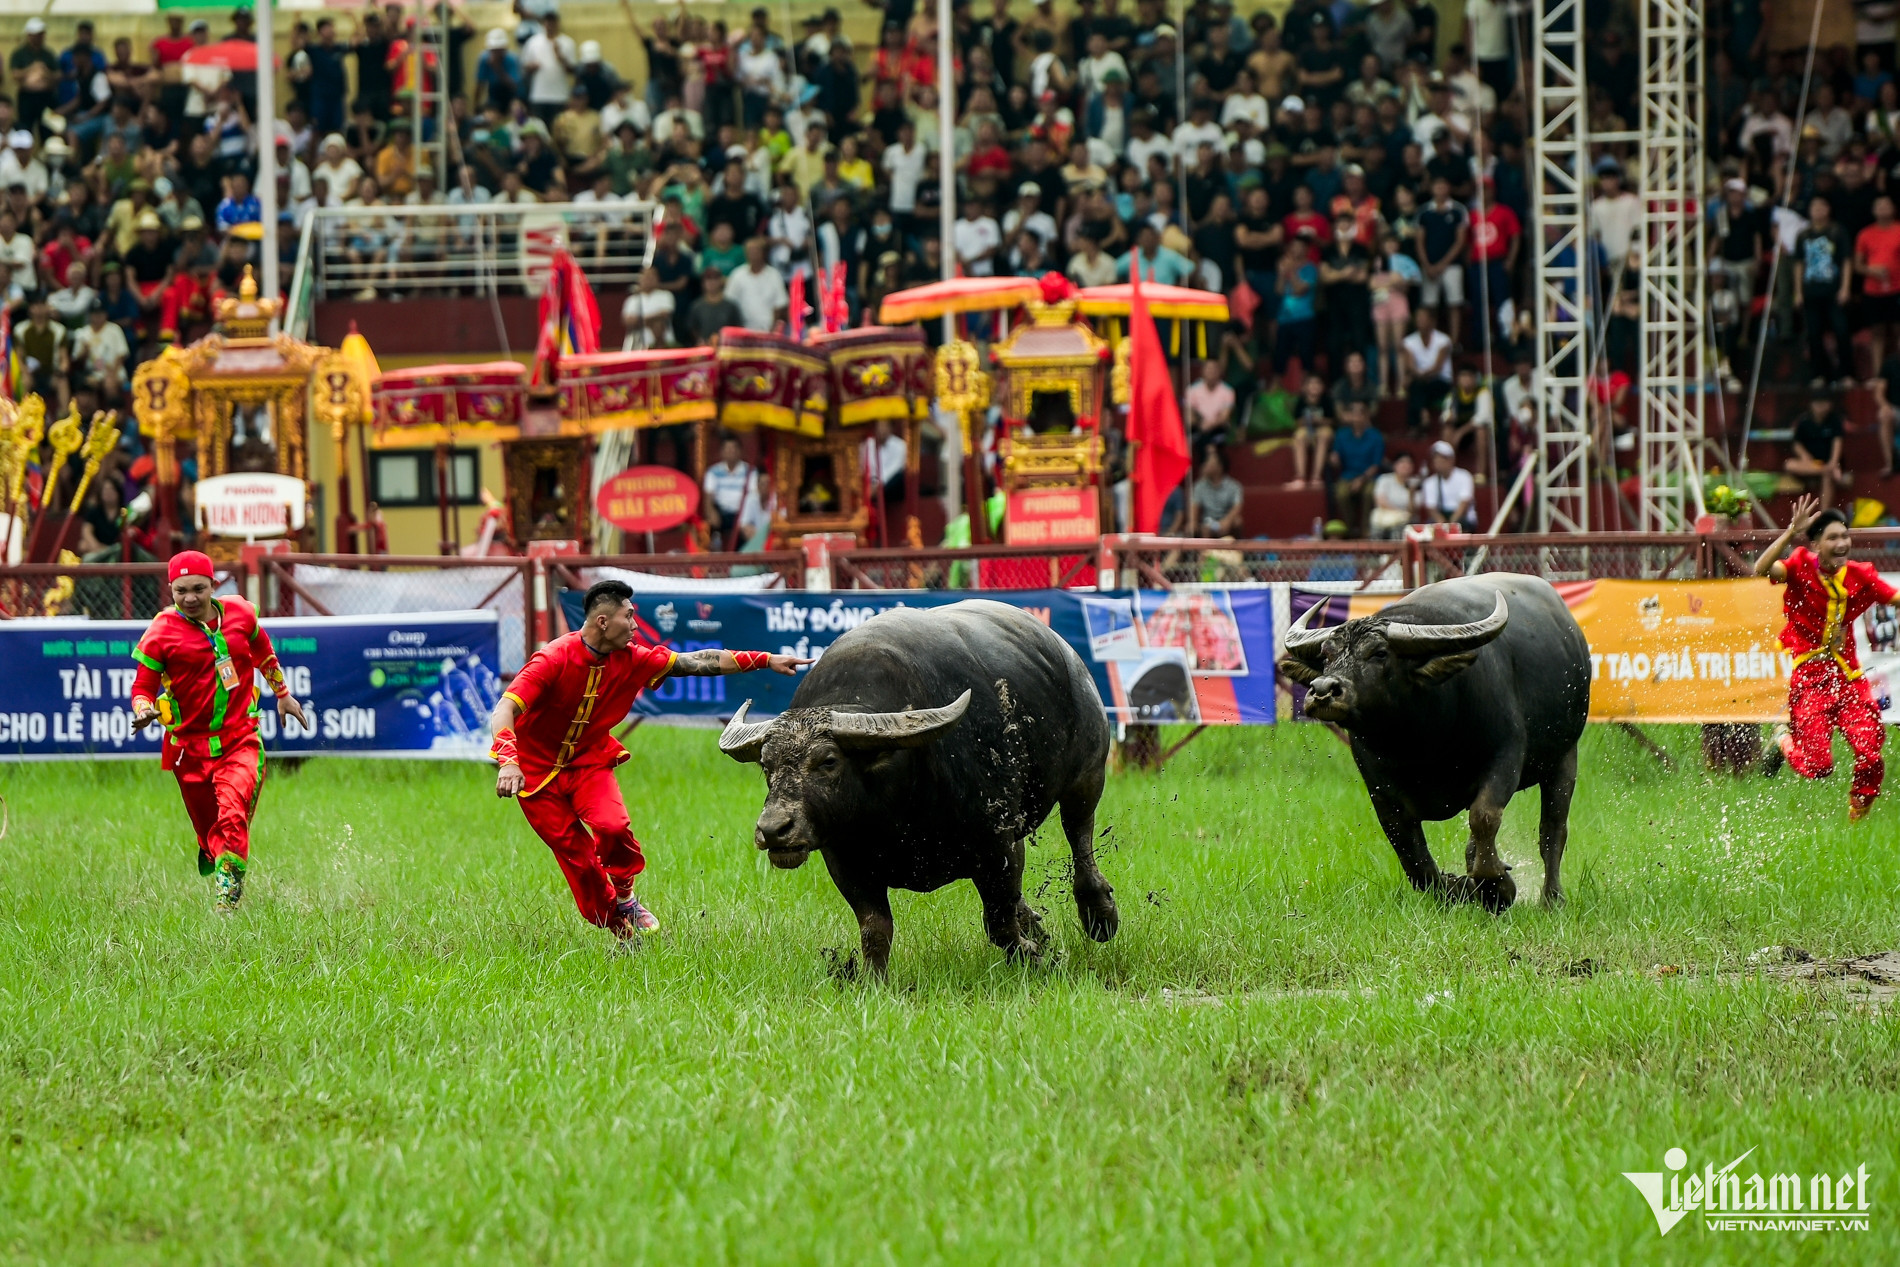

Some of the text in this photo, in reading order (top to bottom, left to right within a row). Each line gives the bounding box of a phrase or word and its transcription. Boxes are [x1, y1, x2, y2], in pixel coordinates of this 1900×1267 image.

[59, 663, 101, 699] TÀI
[1606, 651, 1651, 688] TẠO
[1654, 645, 1694, 681] GIÁ
[1698, 652, 1731, 687] TRỊ
[0, 712, 47, 743] CHO
[53, 702, 85, 742] LỄ
[323, 705, 376, 740] SƠN
